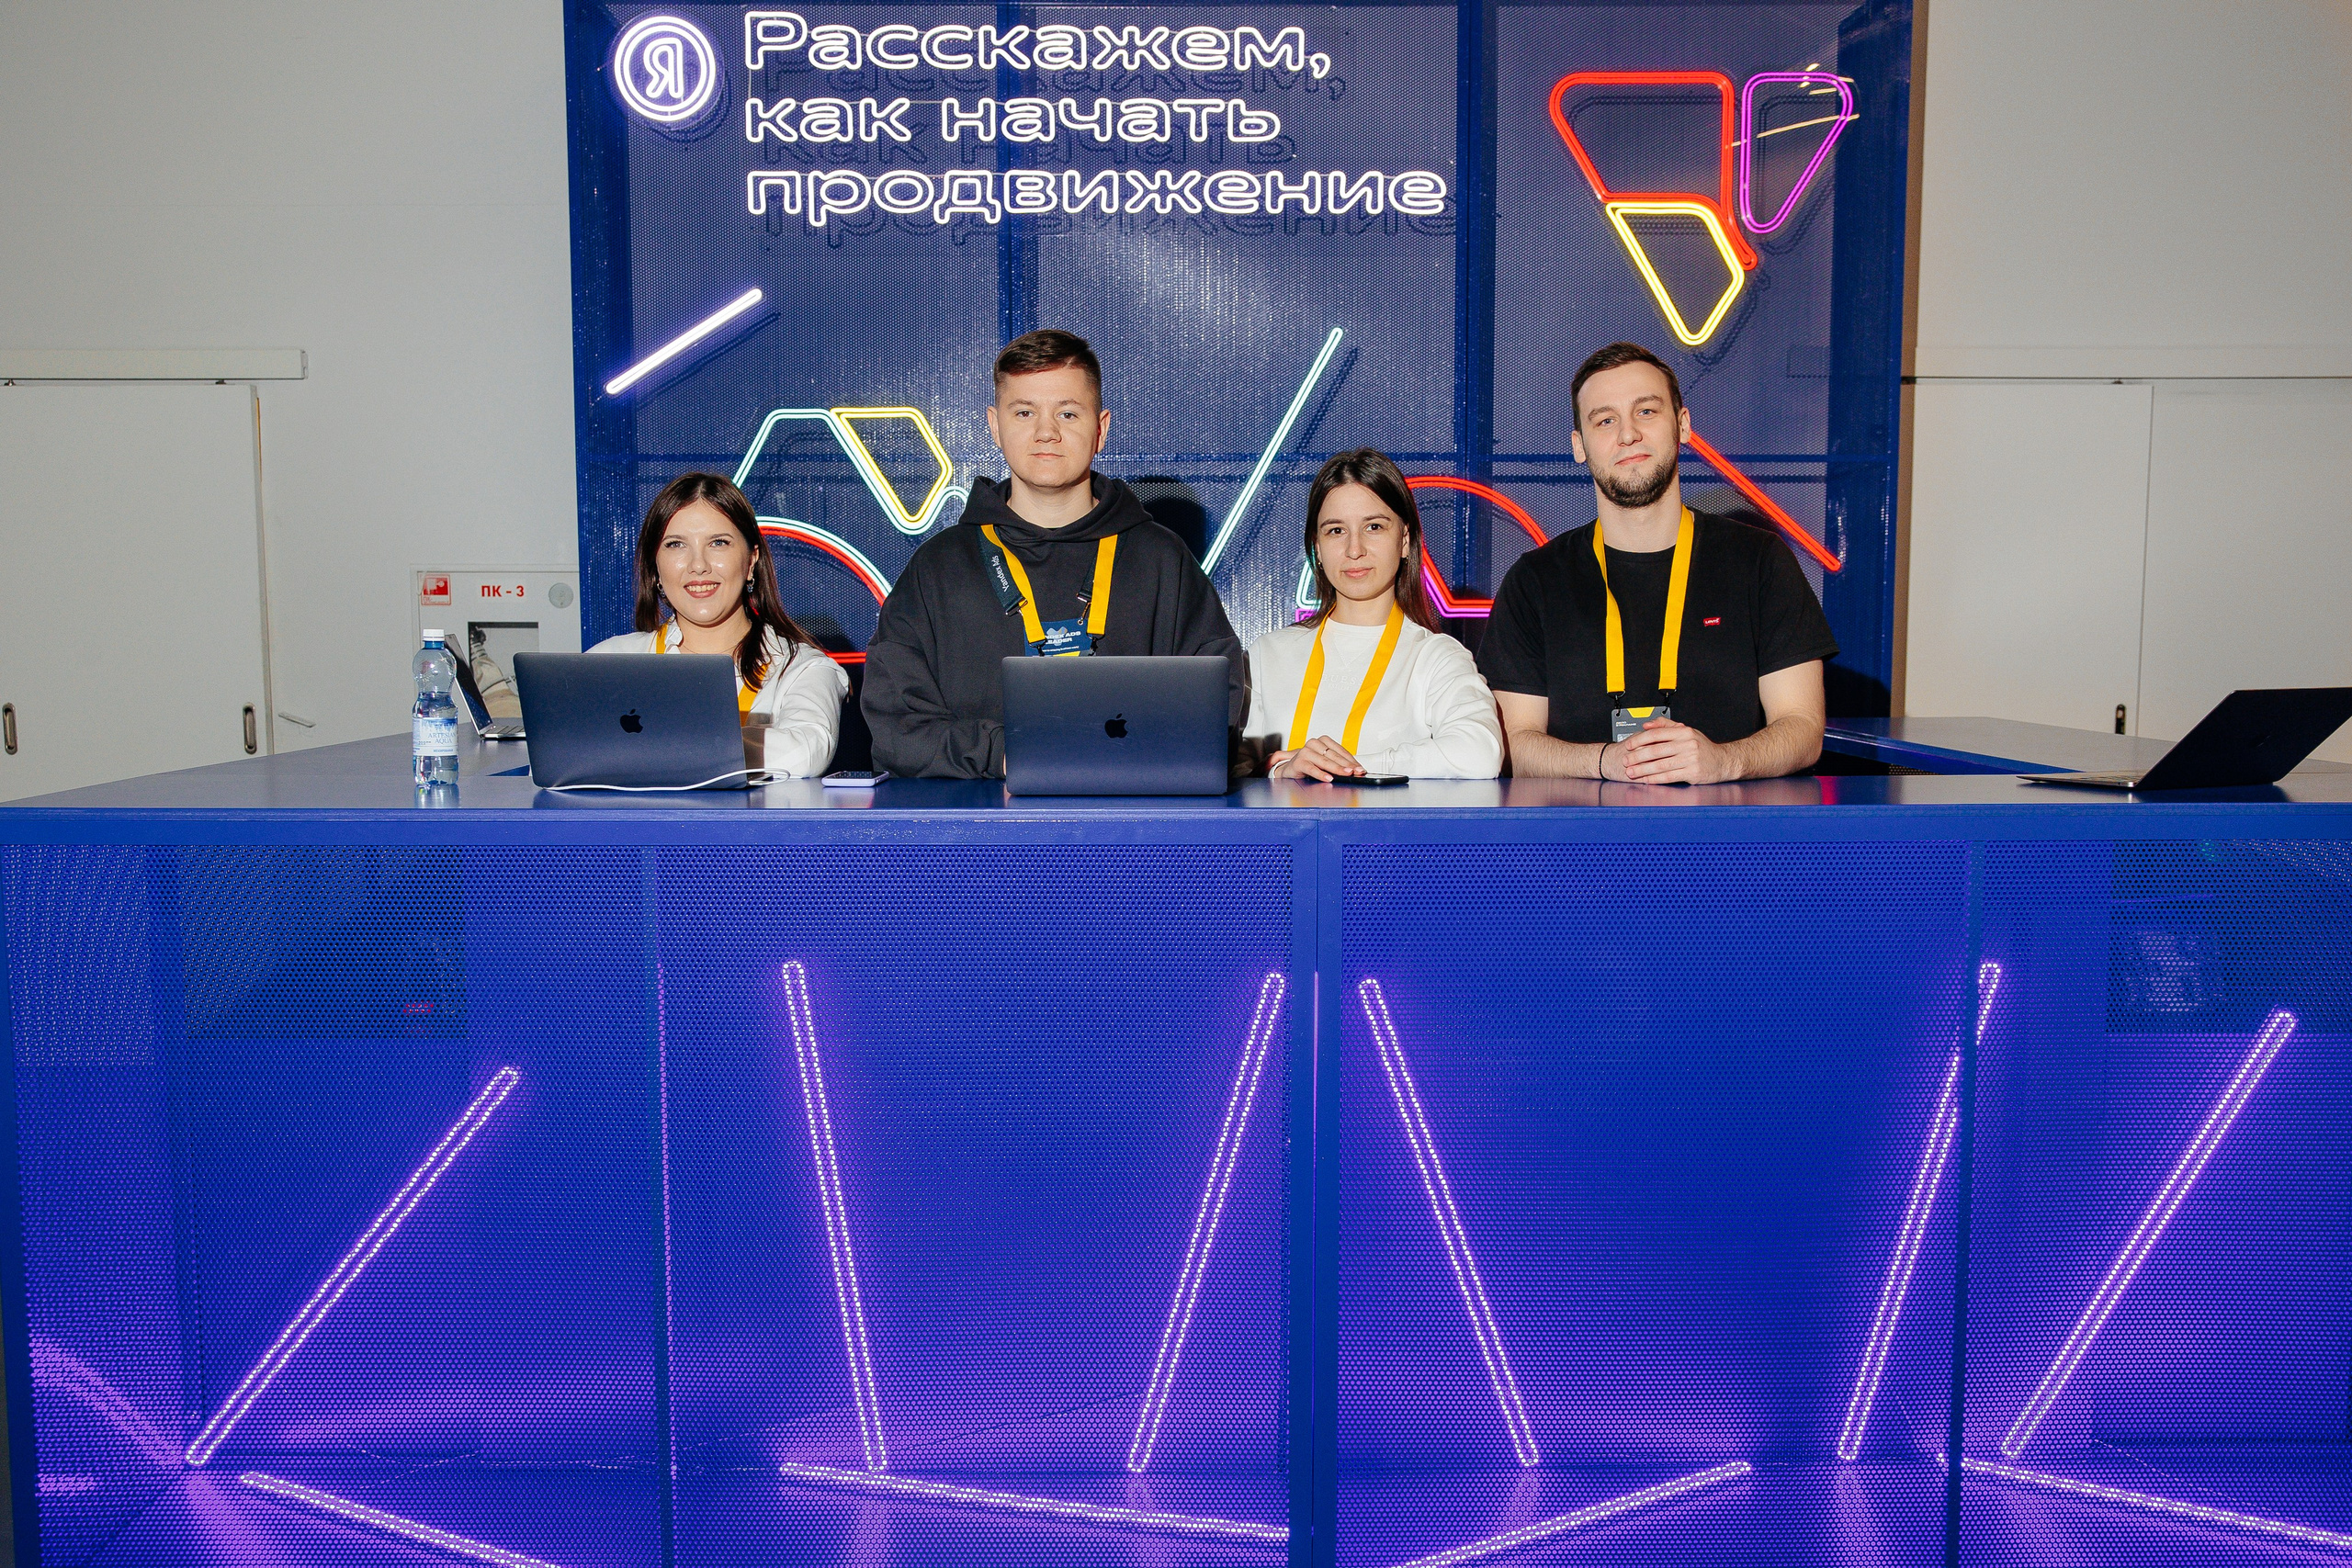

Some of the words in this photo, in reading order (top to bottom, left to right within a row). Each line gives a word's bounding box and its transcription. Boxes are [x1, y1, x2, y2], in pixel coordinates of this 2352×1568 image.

[745, 11, 1331, 79] Расскажем,
[745, 97, 912, 142] как
[942, 97, 1281, 142] начать
[748, 169, 1447, 227] продвижение
[481, 585, 502, 597] ПК
[516, 585, 525, 597] 3
[995, 565, 1010, 592] Yandex
